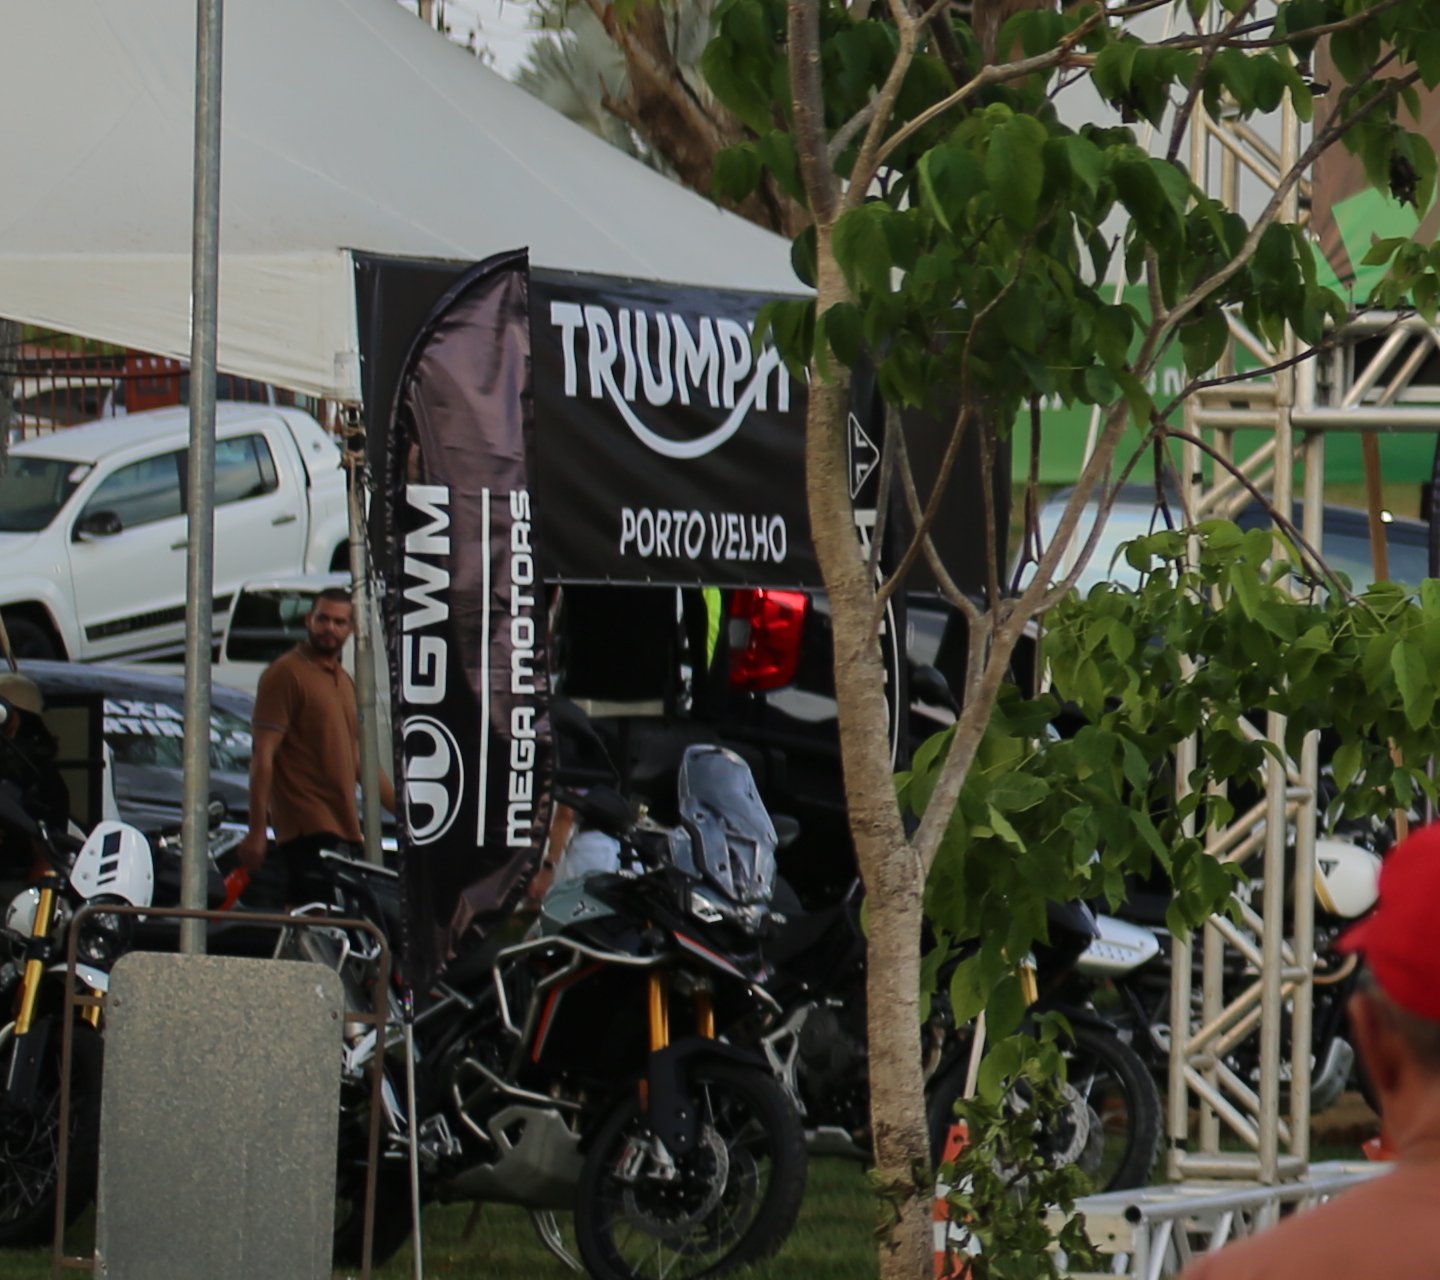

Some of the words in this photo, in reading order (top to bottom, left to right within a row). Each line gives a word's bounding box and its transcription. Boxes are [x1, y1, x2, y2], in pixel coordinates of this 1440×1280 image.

[402, 484, 450, 705] GWM
[509, 489, 536, 695] MOTORS
[619, 506, 706, 560] PORTO
[709, 511, 788, 564] VELHO
[506, 705, 536, 848] MEGA
